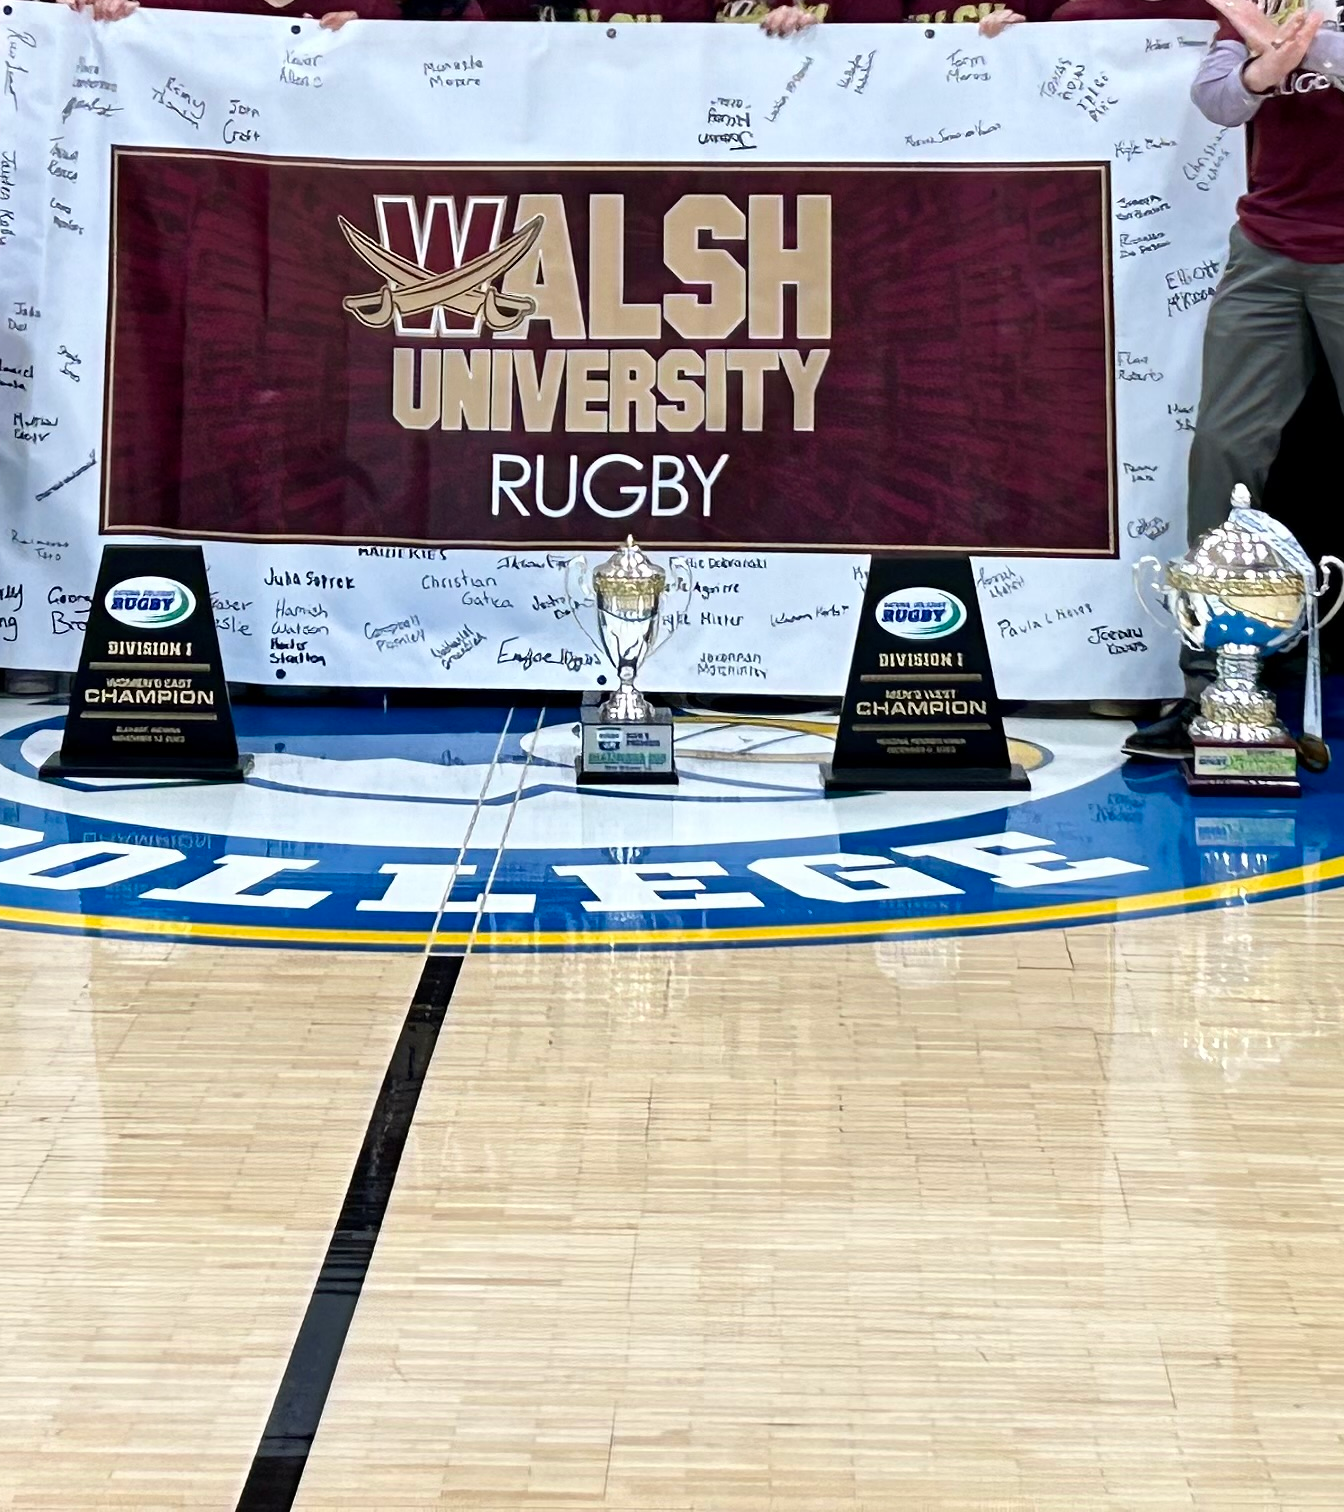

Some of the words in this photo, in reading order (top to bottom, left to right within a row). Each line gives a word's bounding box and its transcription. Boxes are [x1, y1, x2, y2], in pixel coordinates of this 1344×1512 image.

[373, 194, 832, 339] WALSH
[393, 348, 830, 433] UNIVERSITY
[491, 453, 729, 518] RUGBY
[111, 597, 175, 611] RUGBY
[882, 609, 947, 623] RUGBY
[108, 641, 182, 656] DIVISION
[879, 653, 953, 667] DIVISION
[85, 689, 215, 705] CHAMPION
[856, 701, 988, 716] CHAMPION
